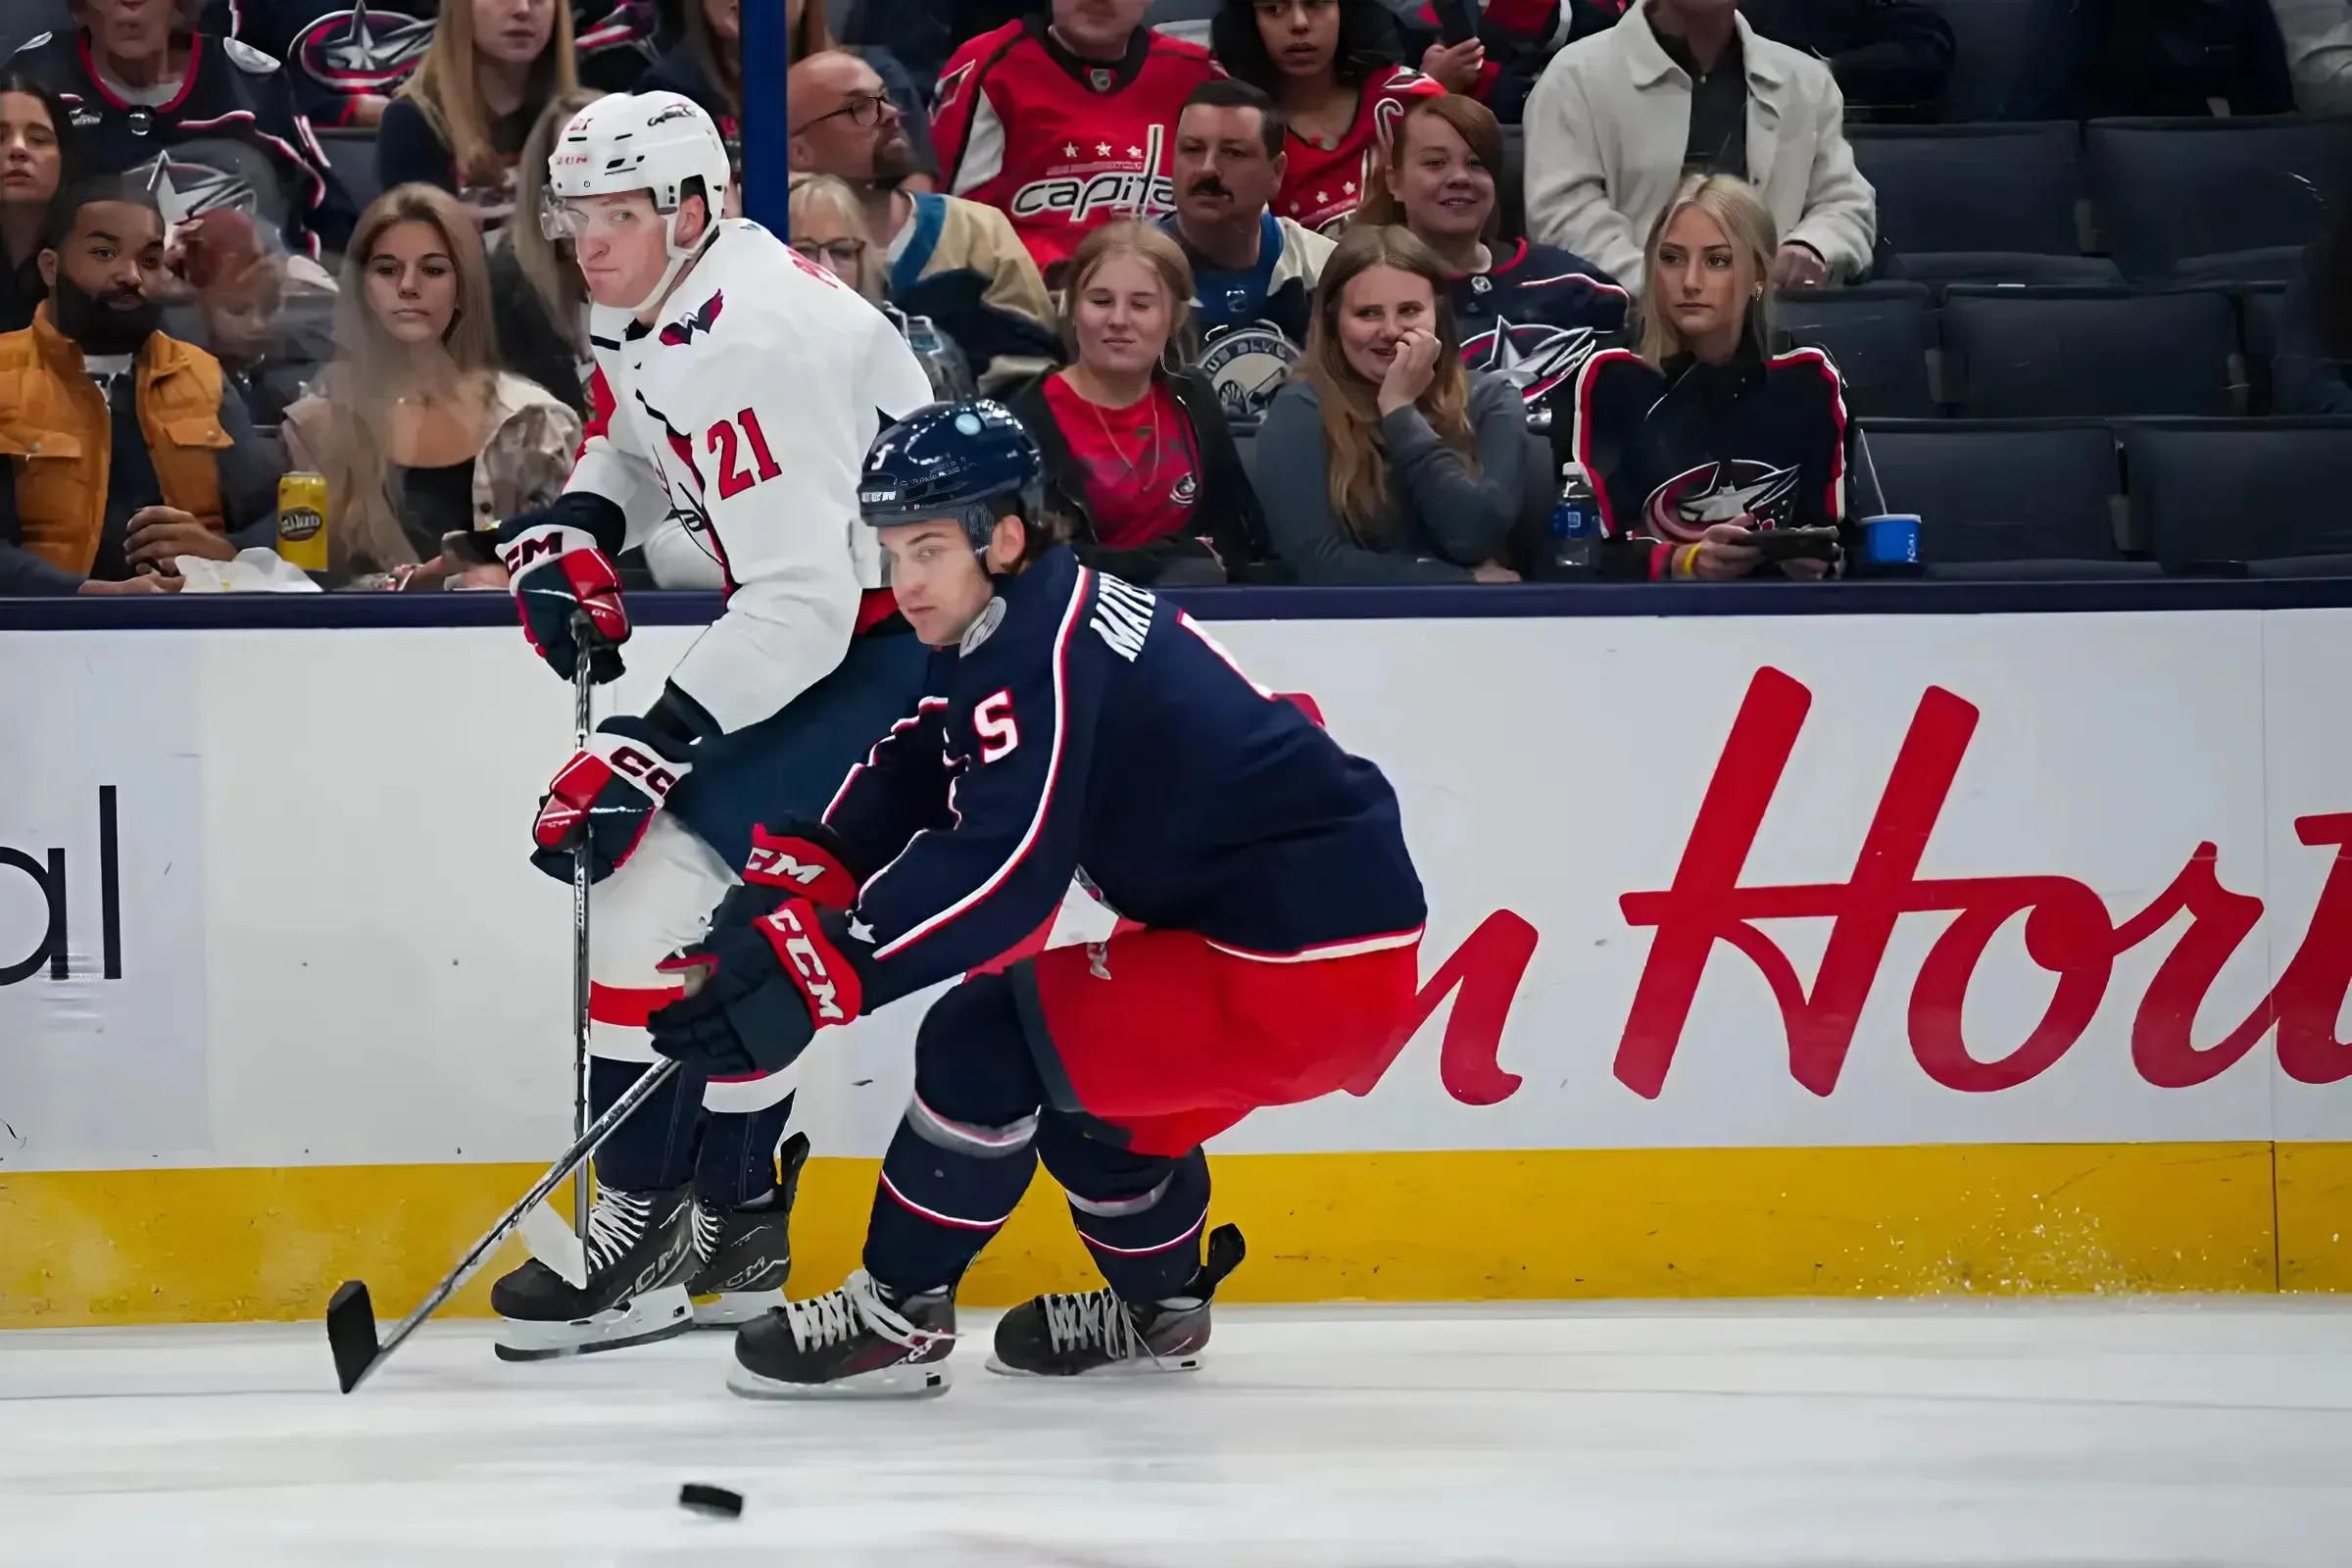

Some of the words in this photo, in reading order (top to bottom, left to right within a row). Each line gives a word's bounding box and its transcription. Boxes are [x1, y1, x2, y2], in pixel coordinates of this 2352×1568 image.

[707, 406, 783, 501] 21
[974, 688, 1019, 765] 5
[767, 908, 845, 1019] CCM
